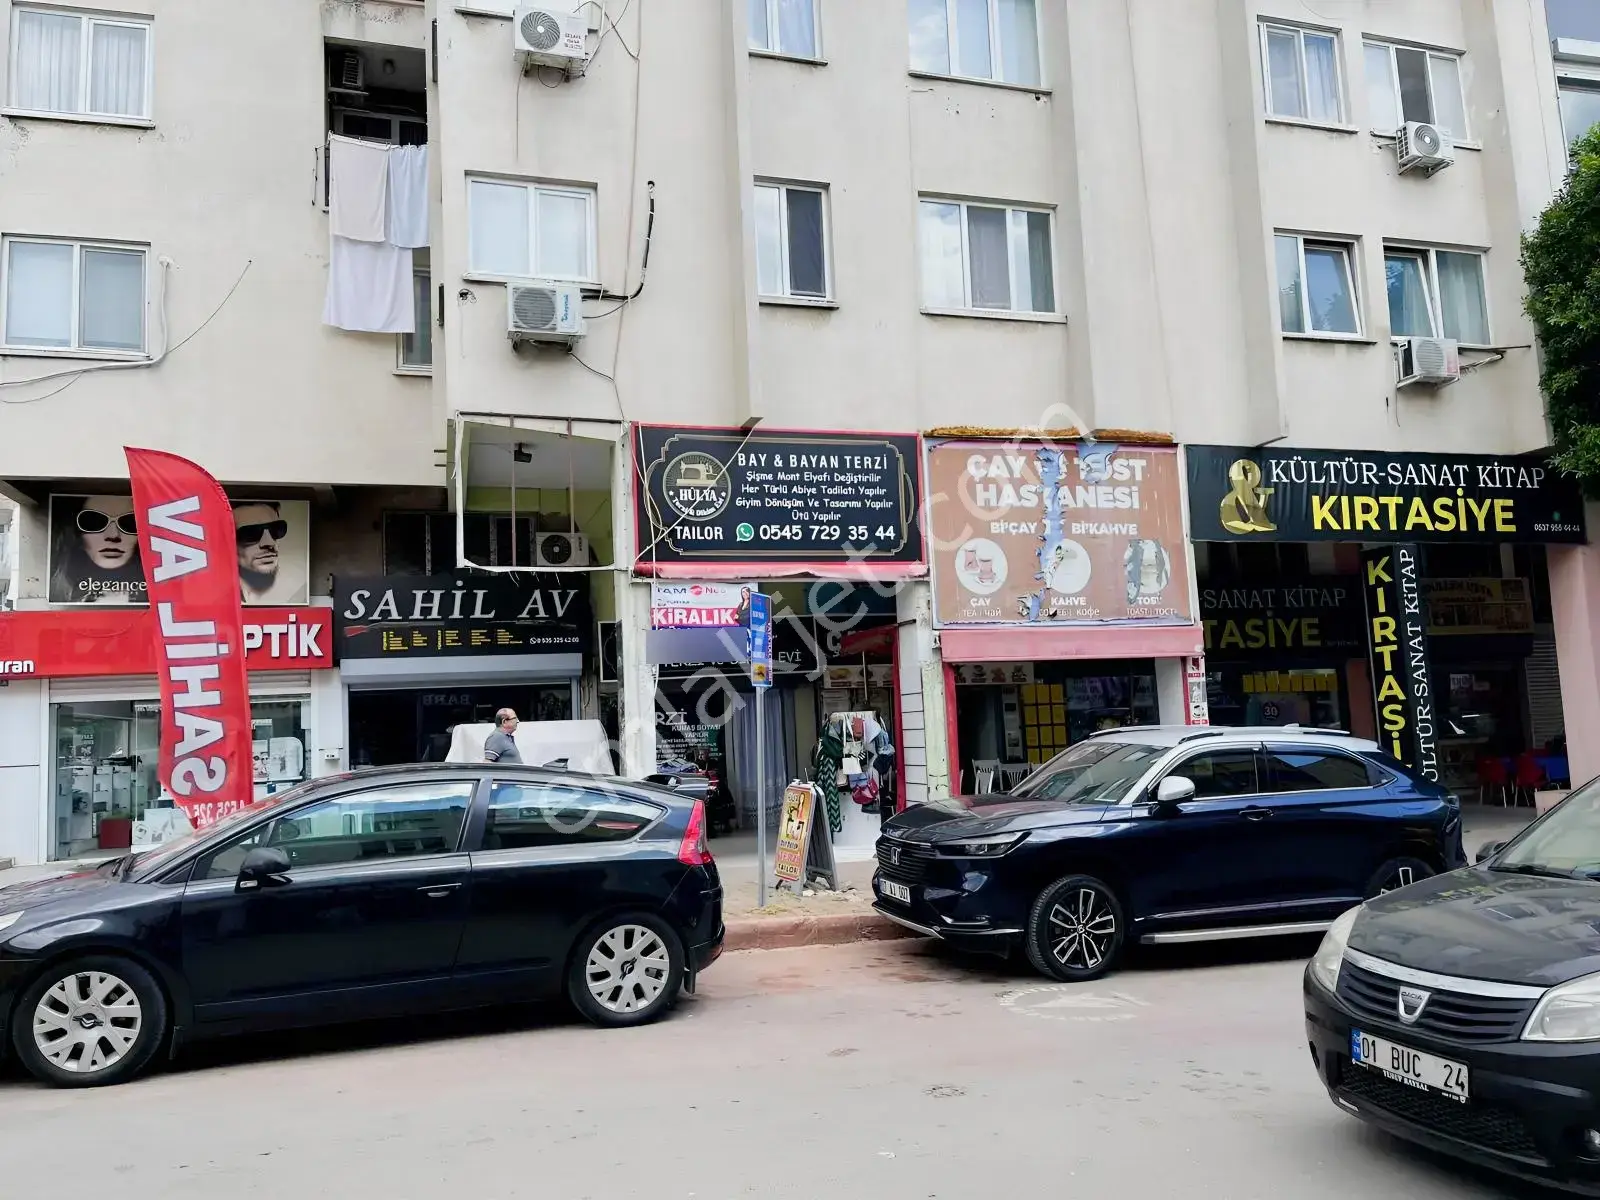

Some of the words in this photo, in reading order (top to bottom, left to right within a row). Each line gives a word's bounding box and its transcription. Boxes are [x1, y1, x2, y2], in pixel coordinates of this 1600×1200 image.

[738, 453, 767, 466] BAY
[774, 455, 783, 467] &
[790, 454, 838, 468] BAYAN
[844, 454, 887, 469] TERZİ
[967, 454, 1026, 482] ÇAY
[1074, 457, 1147, 482] TST
[746, 471, 773, 481] Şişme
[777, 472, 800, 481] Mont
[1269, 456, 1469, 486] KÜLTÜR-SANAT
[1477, 461, 1545, 489] KİTAP
[741, 484, 759, 494] Her
[763, 485, 787, 494] Türlü
[792, 485, 817, 496] Abiye
[858, 486, 887, 497] Yapılır
[735, 497, 761, 508] Giyim
[808, 499, 820, 507] Ve
[864, 500, 893, 510] Yapılır
[1312, 487, 1516, 532] KIRTASİYE
[812, 512, 841, 523] Yapılır
[674, 526, 723, 540] TAILOR
[759, 524, 803, 540] 0545
[809, 525, 840, 541] 729
[848, 525, 868, 541] 35
[875, 525, 896, 540] 44
[78, 577, 147, 591] elegance
[344, 580, 496, 620] SAHİL
[517, 589, 579, 618] AV
[970, 597, 991, 609] ÇAY
[1050, 597, 1086, 606] KAHVE
[1284, 585, 1346, 608] KİTAP
[242, 614, 324, 659] PTİK
[1203, 610, 1322, 649] TASİYE
[1367, 556, 1412, 769] KIRTASİ
[1407, 621, 1438, 782] ÜLTÜR-SANAT
[655, 708, 687, 725] RZİ
[1362, 1038, 1376, 1062] 01
[1391, 1047, 1421, 1077] BUC
[1443, 1064, 1466, 1091] 24
